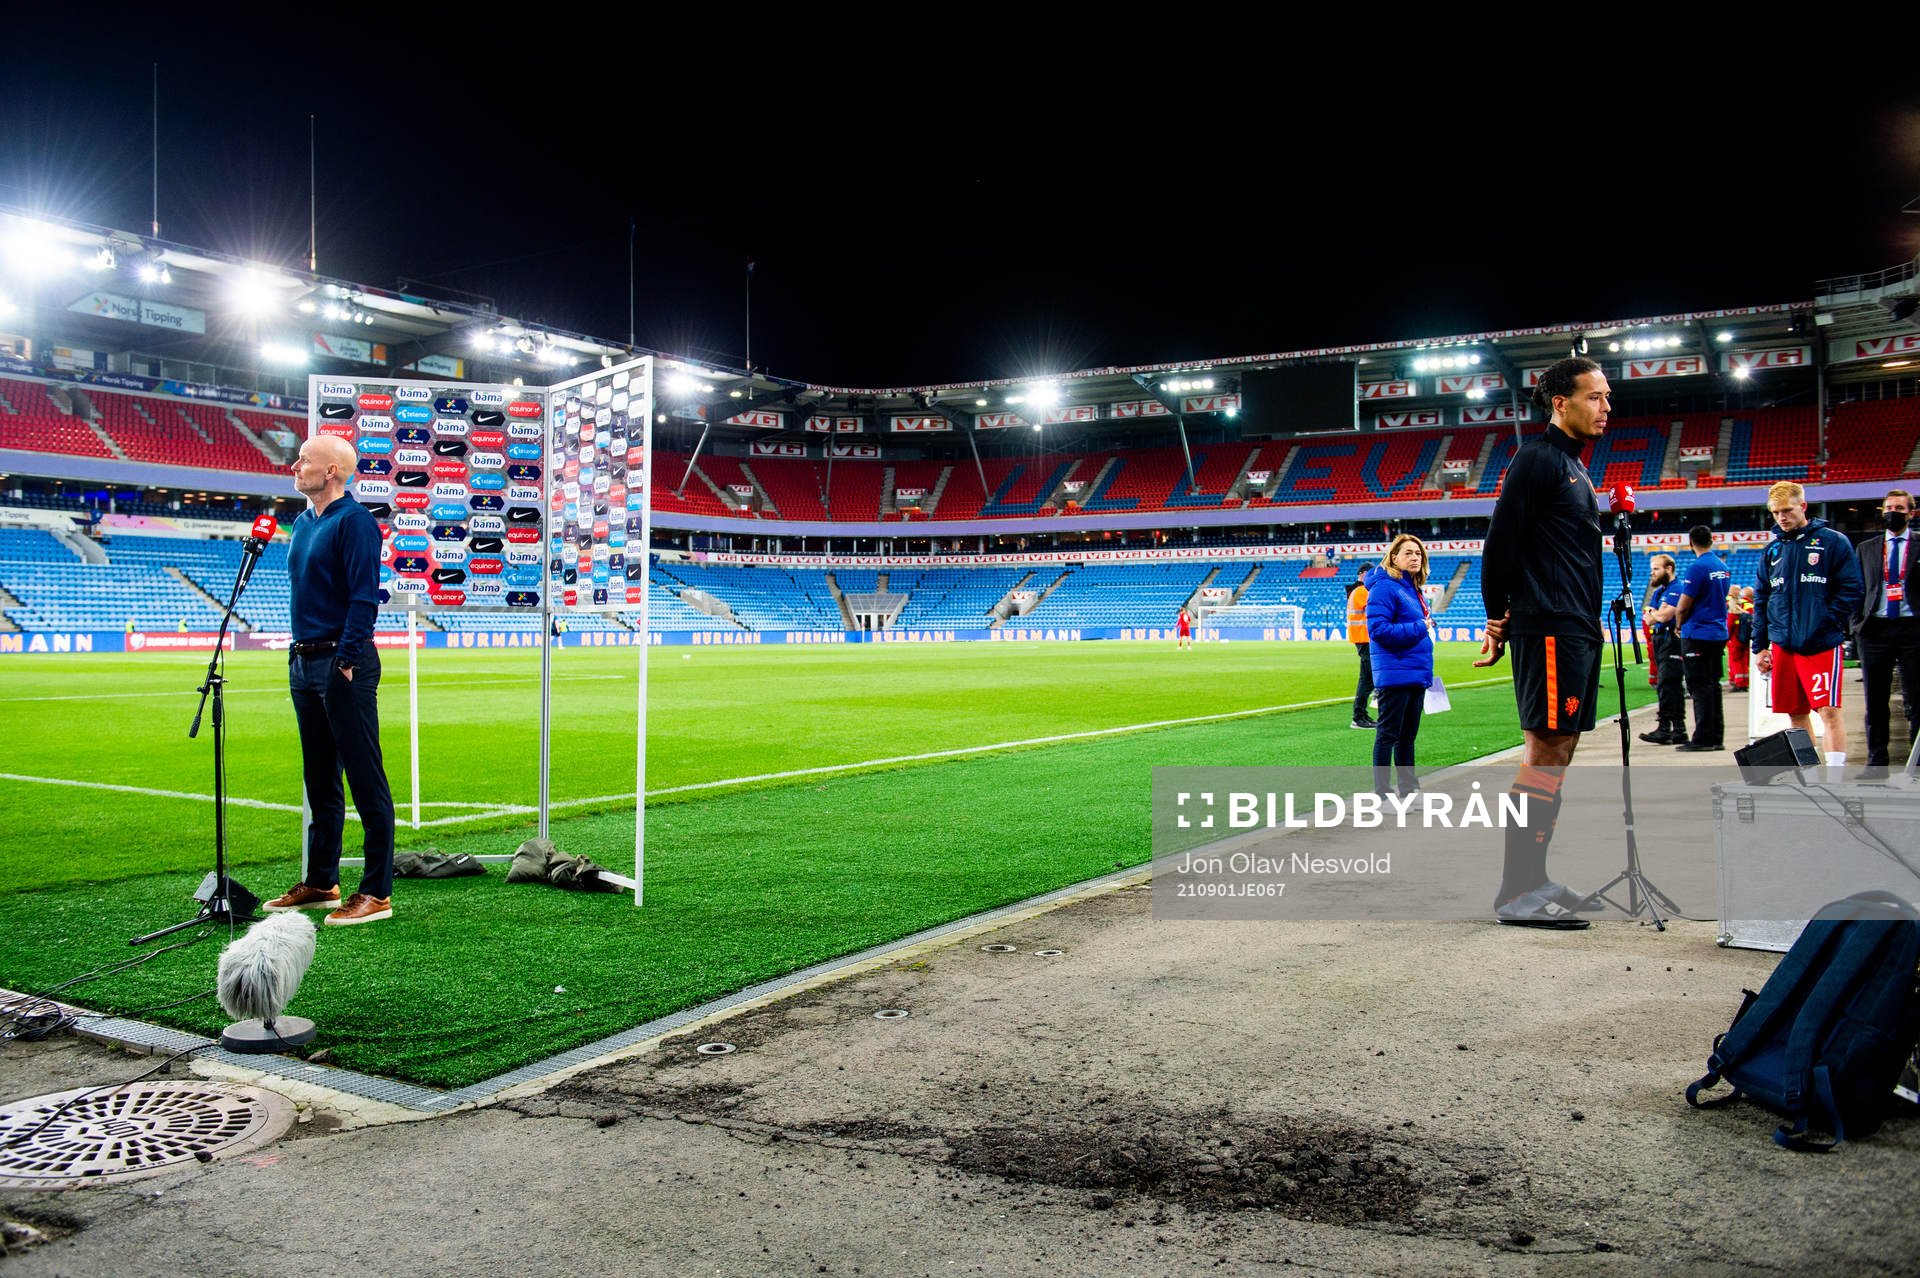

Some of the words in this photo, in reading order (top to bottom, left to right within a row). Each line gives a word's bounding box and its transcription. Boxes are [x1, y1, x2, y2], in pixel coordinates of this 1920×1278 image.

[145, 308, 182, 327] Tipping
[1857, 334, 1920, 357] VG
[1729, 349, 1801, 370] VG
[1630, 358, 1700, 377] VG
[1442, 374, 1503, 392] VG
[324, 384, 352, 394] bama
[400, 388, 428, 398] bama
[475, 392, 502, 401] bama
[1118, 401, 1168, 416] VG
[1186, 396, 1239, 411] VG
[1047, 408, 1093, 422] VG
[1465, 405, 1525, 422] VG
[361, 418, 390, 429] bama
[735, 413, 779, 427] VG
[899, 418, 946, 430] VG
[980, 414, 1024, 427] VG
[1379, 412, 1438, 427] VG
[437, 422, 465, 432] bama
[814, 418, 857, 432] VG
[511, 426, 539, 436] bama
[755, 443, 805, 455] VG
[831, 445, 878, 457] VG
[1680, 448, 1710, 456] VG
[399, 452, 427, 462] bama
[474, 455, 501, 465] bama
[360, 483, 389, 493] bama
[436, 486, 464, 496] bama
[511, 489, 538, 498] bama
[398, 517, 426, 526] bama
[473, 519, 500, 529] bama
[1647, 536, 1681, 544] VG
[1733, 533, 1769, 541] VG
[435, 550, 463, 559] bama
[1274, 546, 1301, 554] VG
[510, 552, 537, 561] bama
[1800, 573, 1826, 584] bama
[397, 582, 425, 591] bama
[473, 582, 500, 592] bama
[1811, 672, 1830, 693] 21
